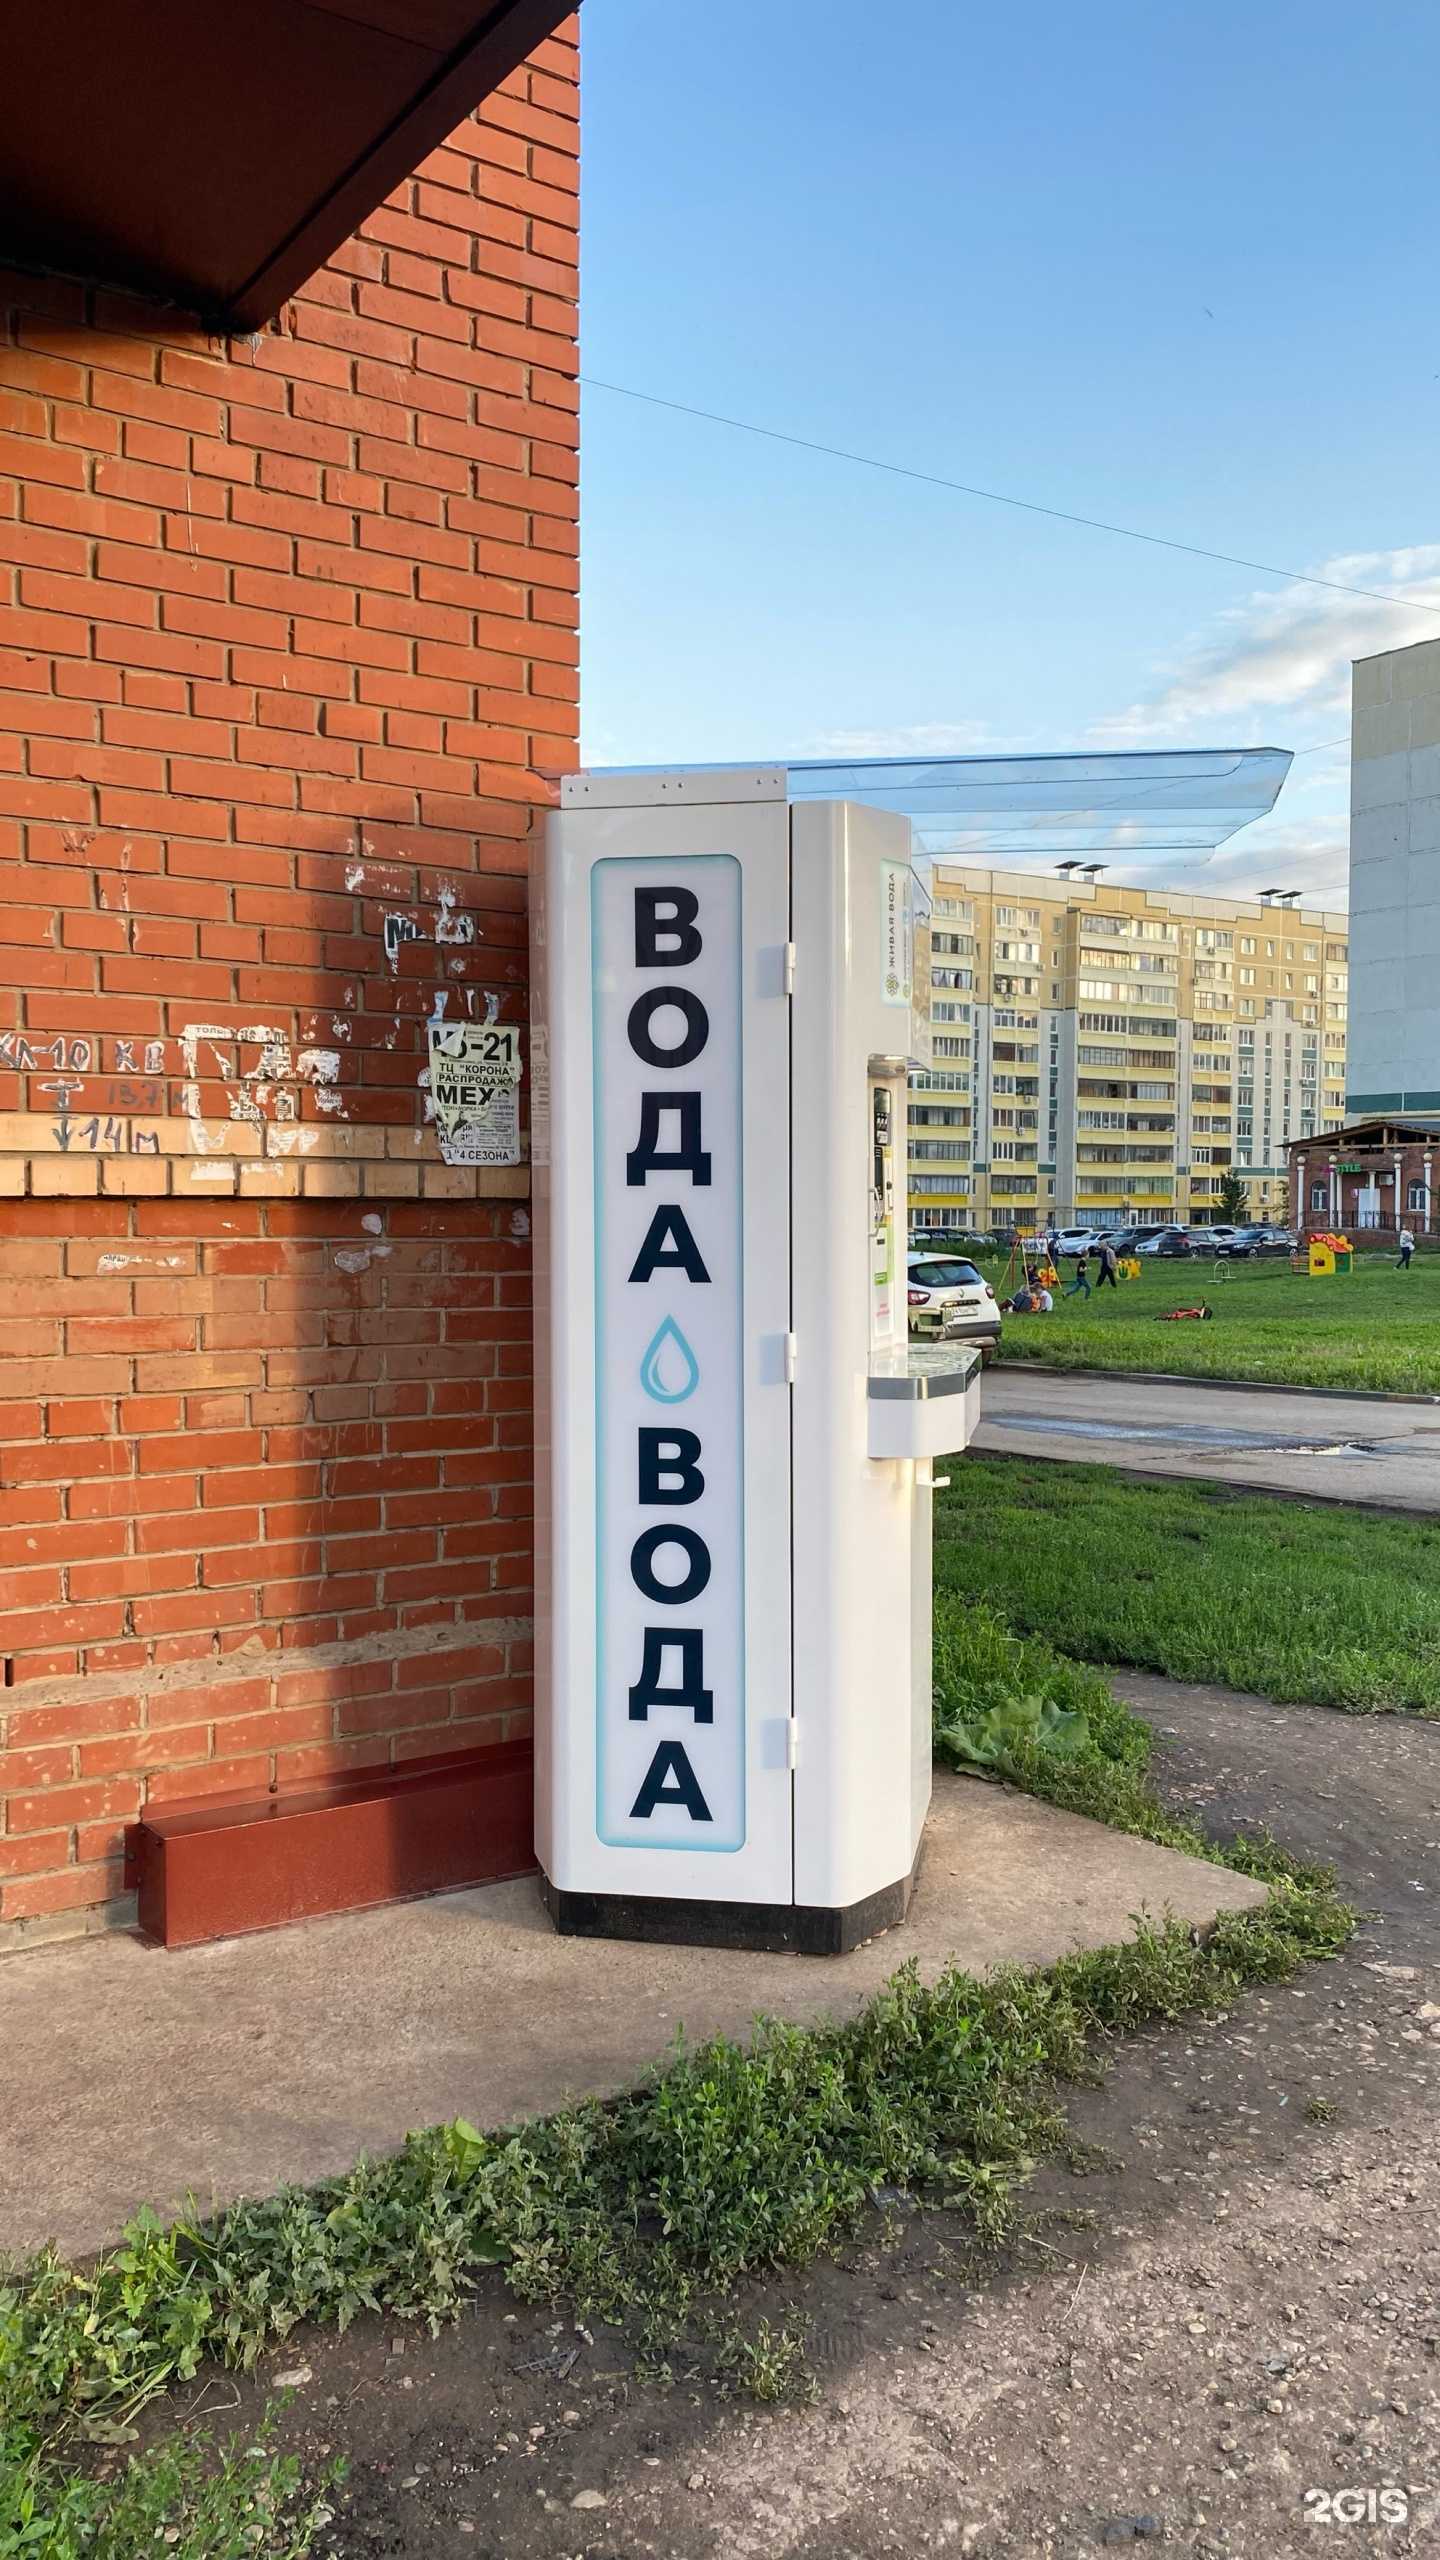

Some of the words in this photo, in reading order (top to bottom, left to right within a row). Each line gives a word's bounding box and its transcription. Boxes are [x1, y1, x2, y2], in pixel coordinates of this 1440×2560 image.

[440, 1063, 454, 1074] ТЦ
[626, 886, 713, 1284] ВОДА
[628, 1427, 714, 1822] ВОДА
